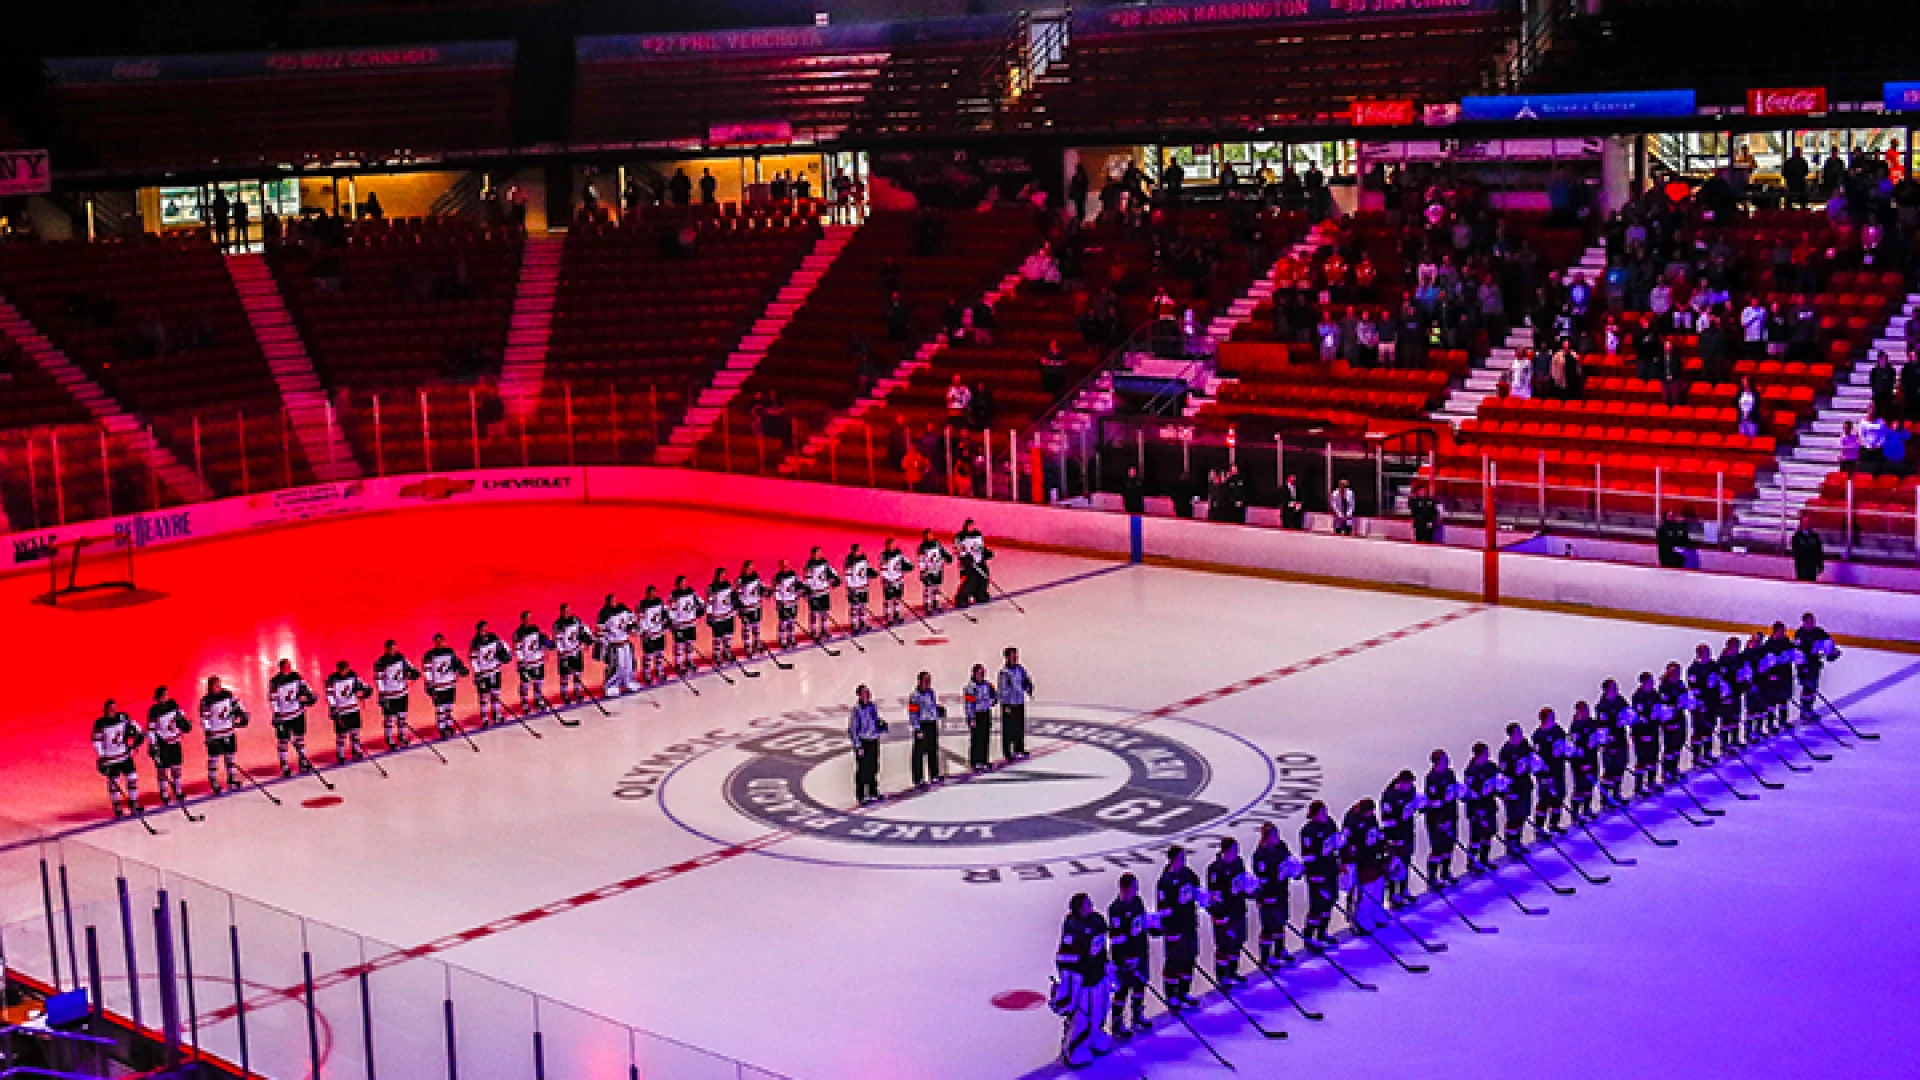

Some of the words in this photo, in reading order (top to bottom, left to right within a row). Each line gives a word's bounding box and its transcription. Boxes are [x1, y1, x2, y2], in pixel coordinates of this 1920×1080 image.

[680, 35, 720, 51] PHIL
[727, 29, 823, 49] VERCHOTA
[482, 477, 572, 490] CHEVROLET
